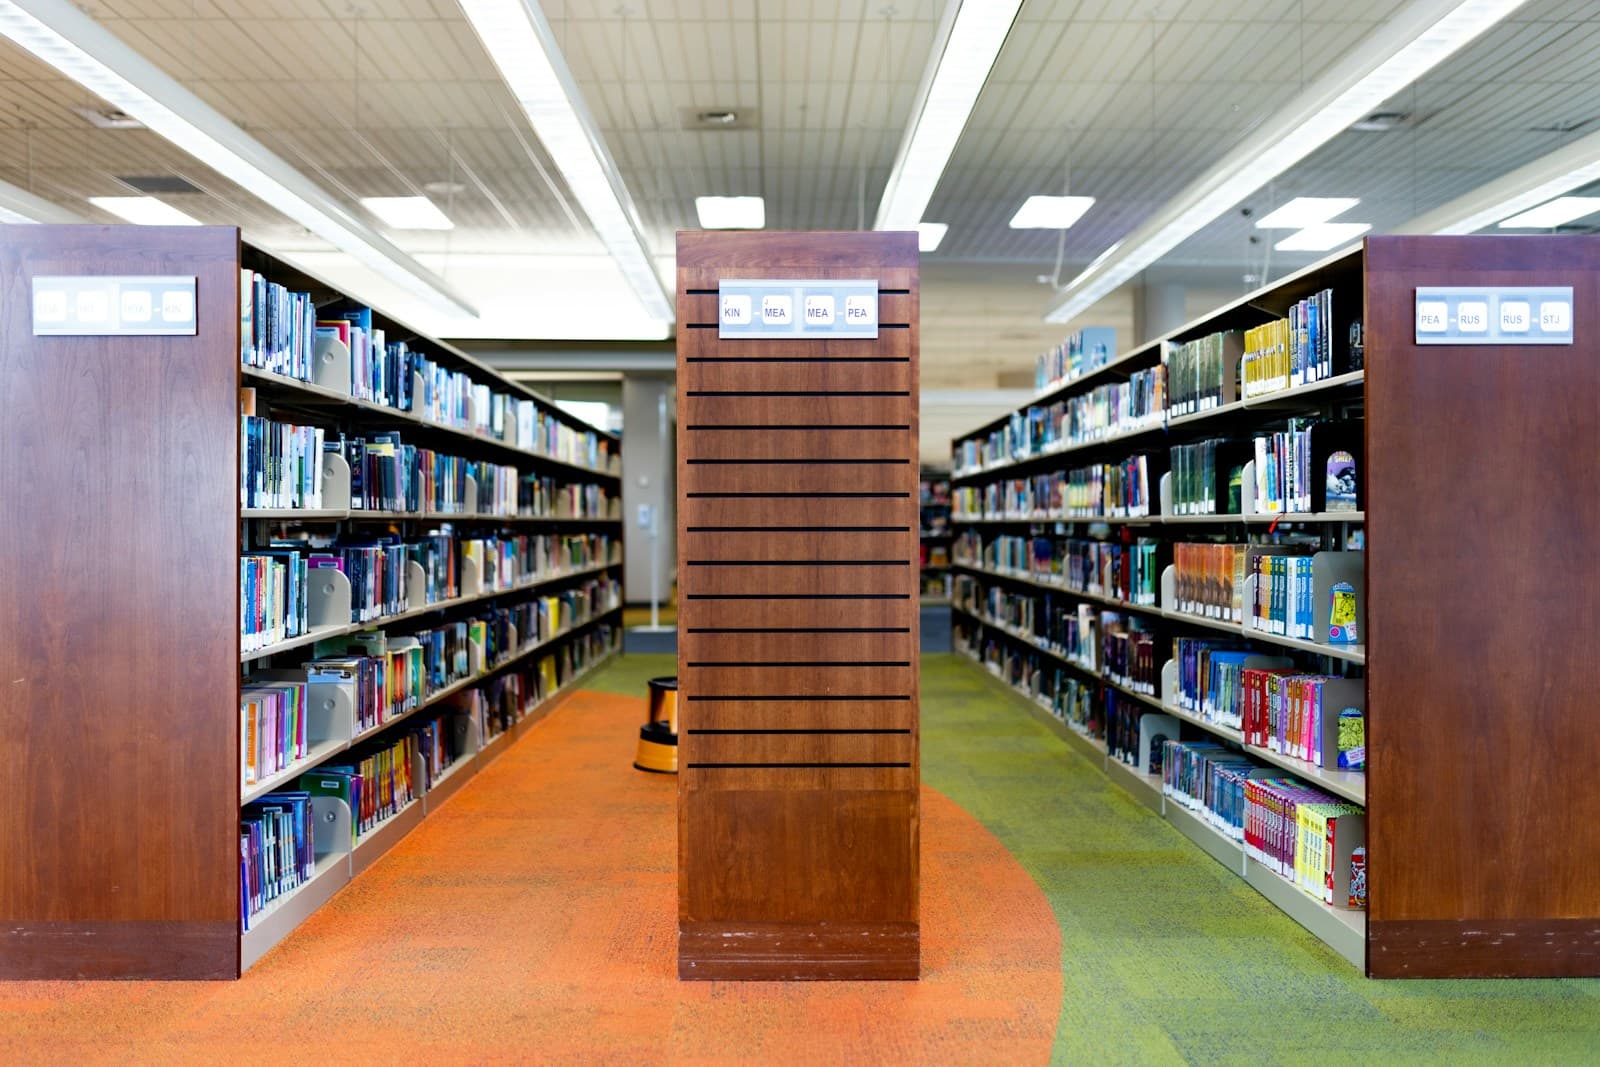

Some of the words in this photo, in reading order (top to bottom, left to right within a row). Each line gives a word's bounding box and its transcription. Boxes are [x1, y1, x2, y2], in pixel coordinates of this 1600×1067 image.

[724, 308, 741, 318] KIN
[764, 308, 786, 318] MEA
[807, 308, 829, 318] MEA
[847, 308, 867, 318] PEA
[1421, 315, 1440, 324] PEA
[1460, 315, 1480, 324] RUS
[1503, 315, 1523, 324] RUS
